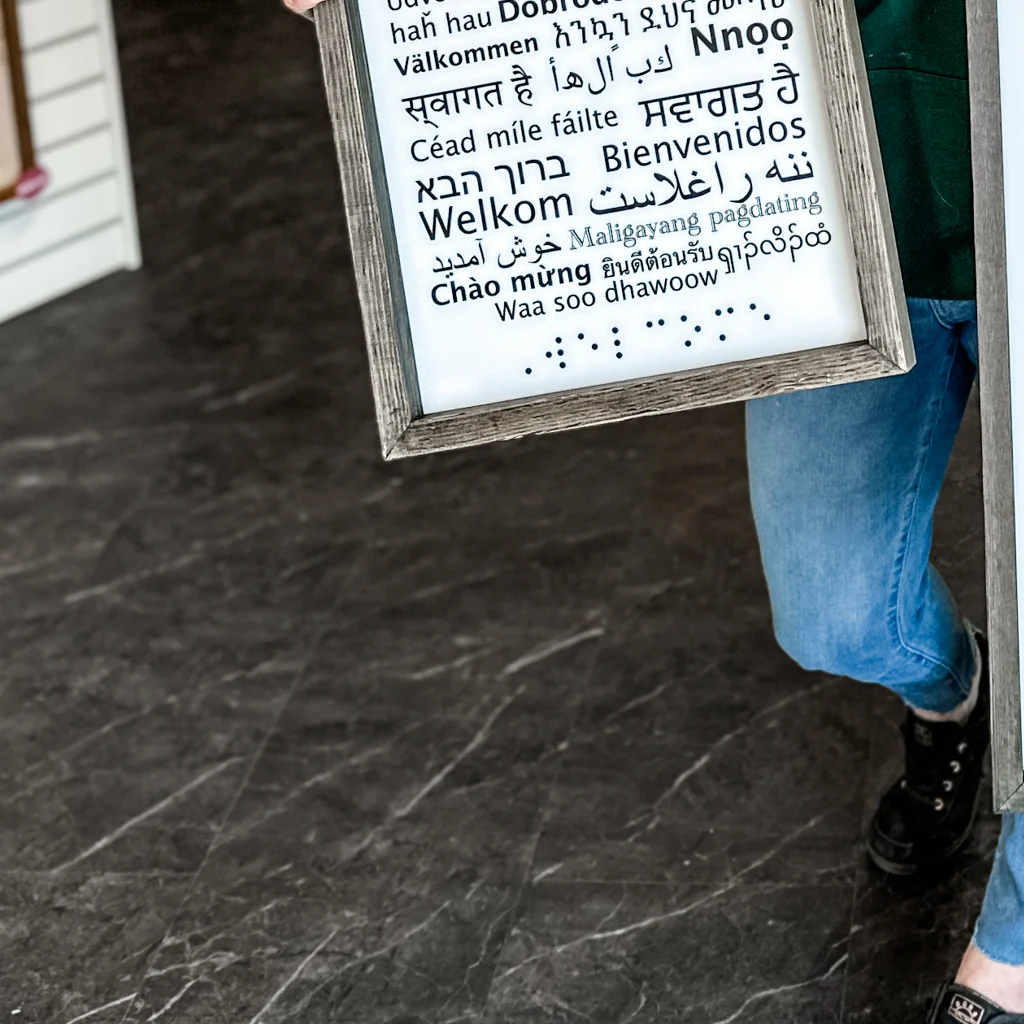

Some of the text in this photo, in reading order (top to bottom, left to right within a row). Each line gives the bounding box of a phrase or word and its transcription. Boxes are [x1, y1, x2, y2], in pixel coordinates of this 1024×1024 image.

[445, 11, 492, 34] hau
[393, 37, 538, 76] Välkommen
[510, 64, 533, 106] है
[771, 63, 800, 104] ਹੈ
[411, 108, 618, 162] Céad míle fáilte
[602, 116, 806, 172] Bienvenidos
[415, 155, 570, 203] ברוך הבא
[419, 193, 573, 241] Welkom
[568, 191, 822, 250] Maligayang pagdating
[497, 233, 562, 269] خوش
[602, 240, 713, 279] ยินดีต้อนรับ
[431, 263, 591, 306] Chào mừng
[494, 269, 718, 322] Waa soo dhawoow
